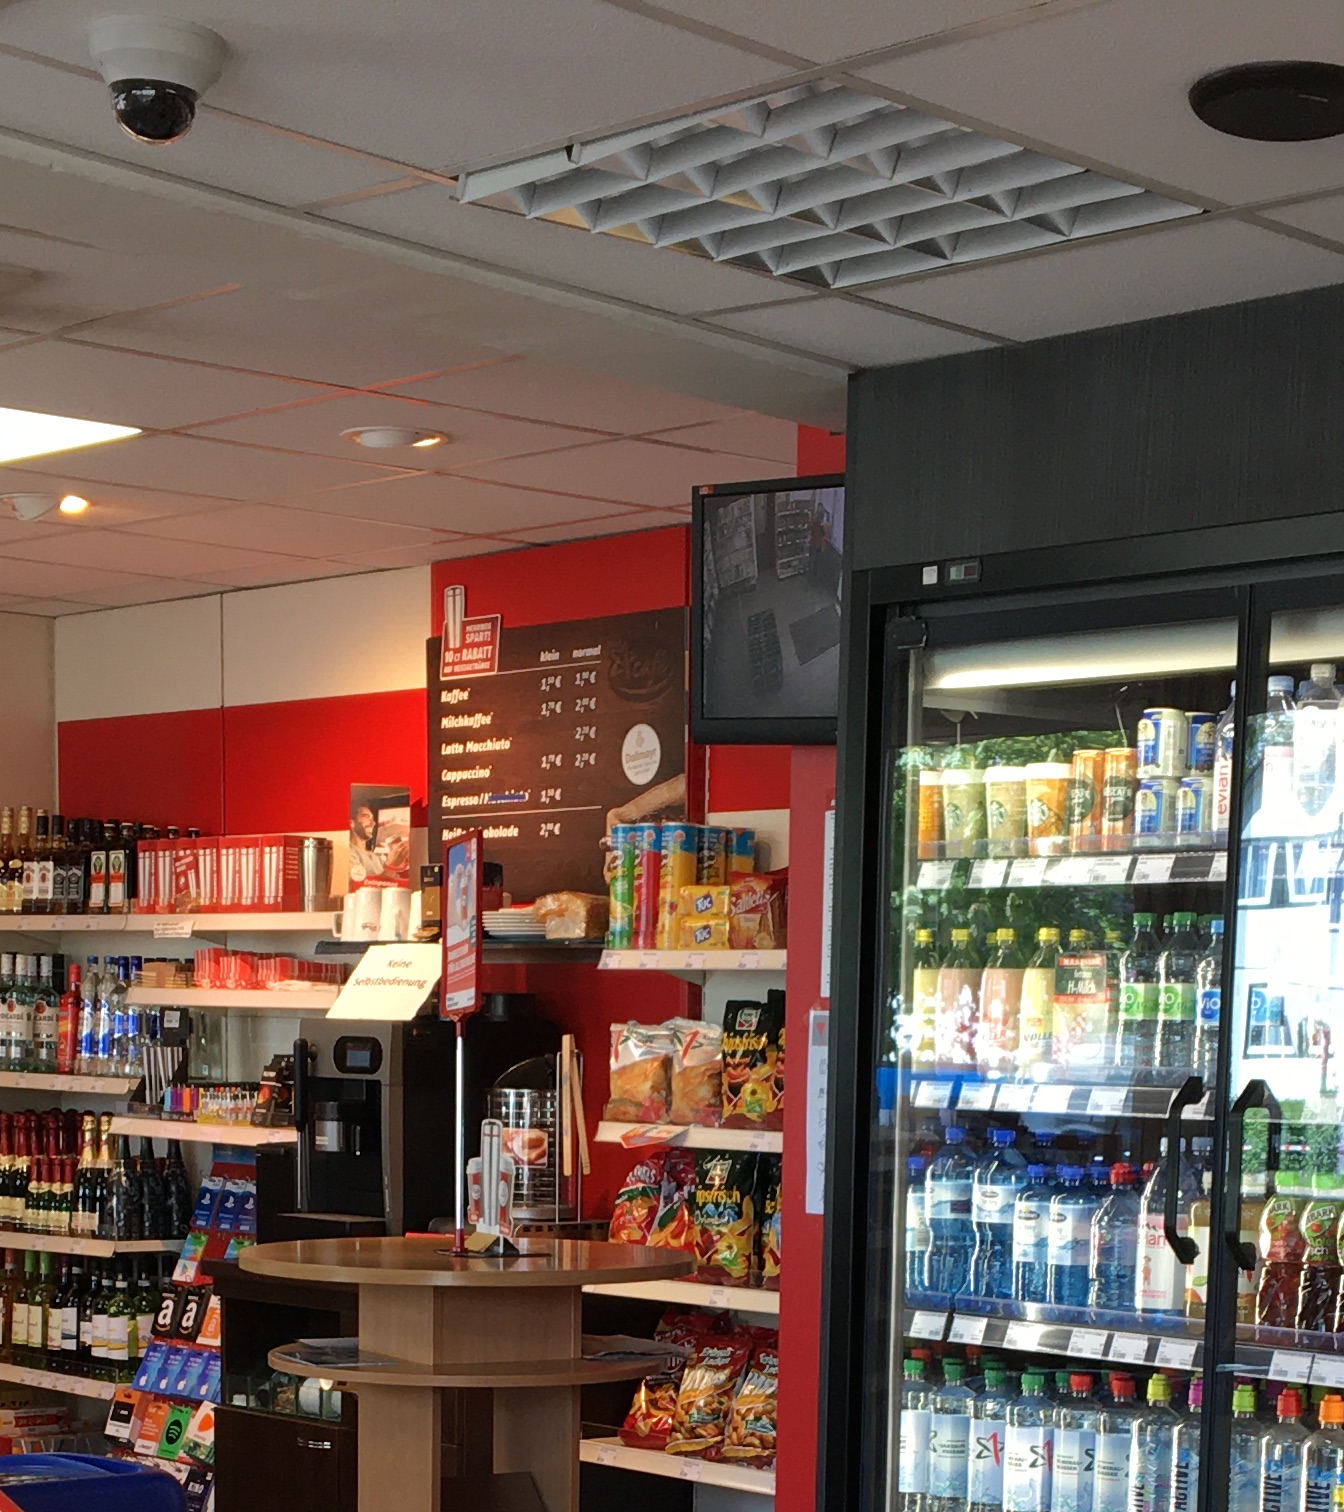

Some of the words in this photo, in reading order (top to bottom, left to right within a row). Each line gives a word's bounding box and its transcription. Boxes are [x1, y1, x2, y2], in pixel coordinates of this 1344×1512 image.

[465, 631, 492, 643] SPART!
[444, 651, 453, 663] 10
[461, 646, 492, 661] RABATT
[540, 650, 560, 662] klein
[572, 645, 601, 658] normal
[441, 742, 464, 755] Latte
